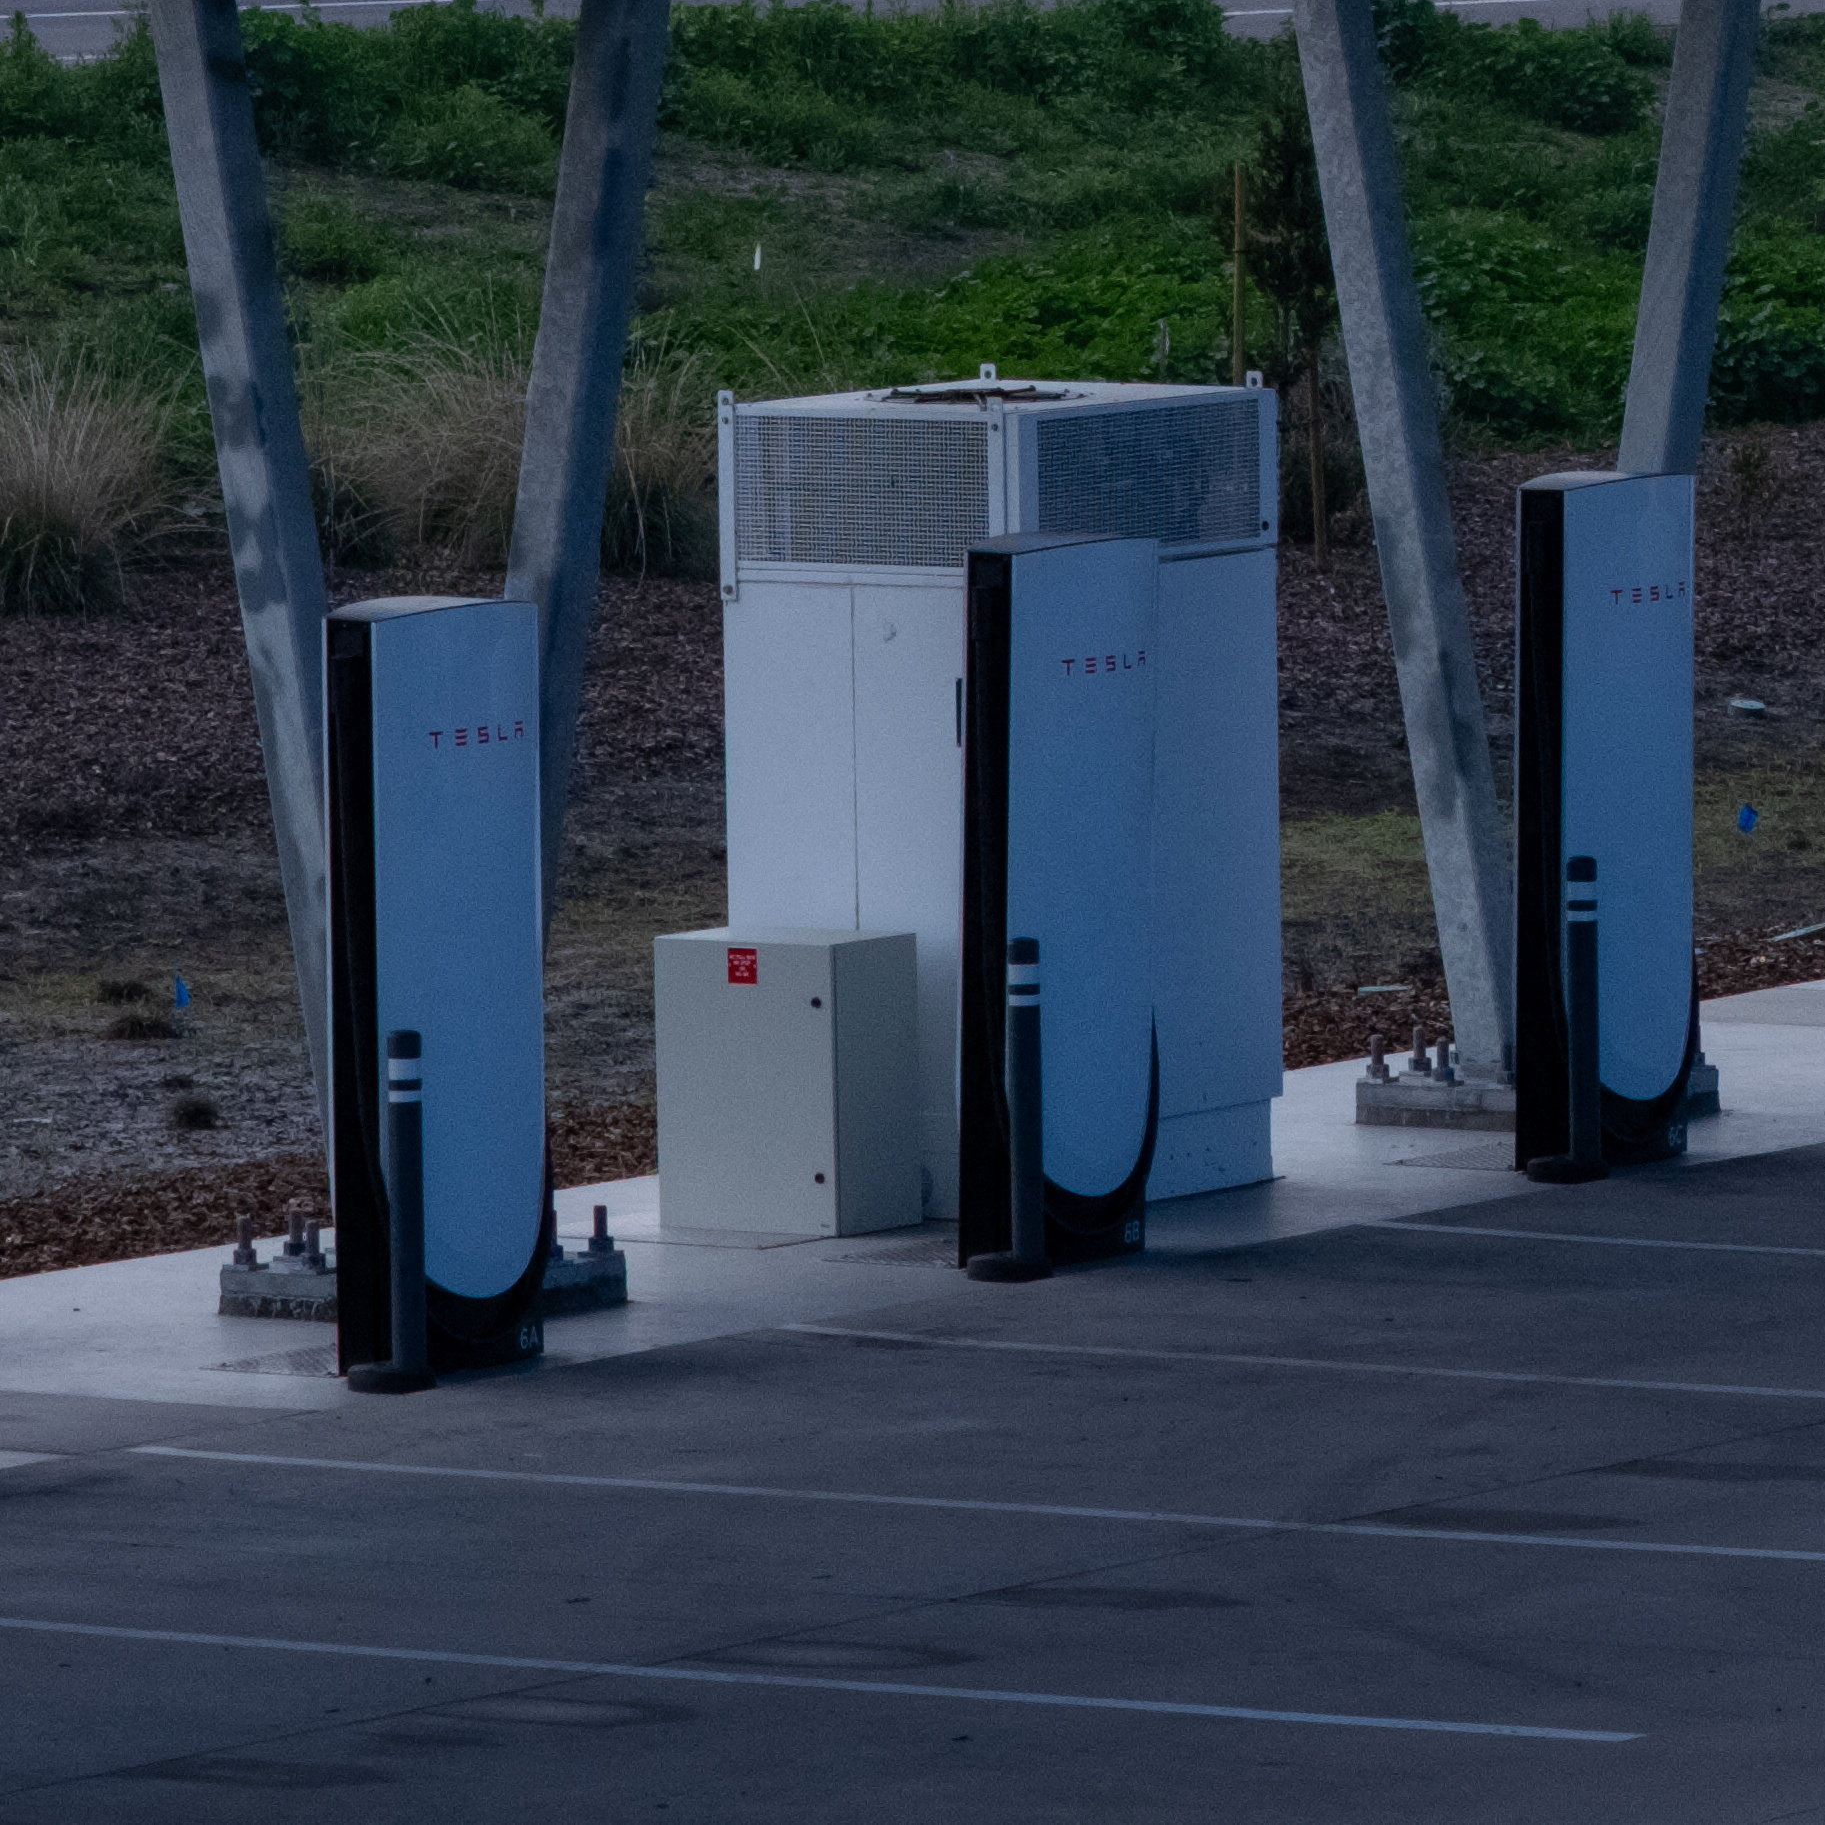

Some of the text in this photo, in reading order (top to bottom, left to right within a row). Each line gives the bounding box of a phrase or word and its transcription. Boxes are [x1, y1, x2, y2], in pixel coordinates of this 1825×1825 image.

[1610, 582, 1685, 603] TESLA
[1062, 650, 1146, 675] TESLA
[429, 721, 525, 748] TESLA
[1125, 1221, 1140, 1243] 6B
[520, 1326, 539, 1349] 6A
